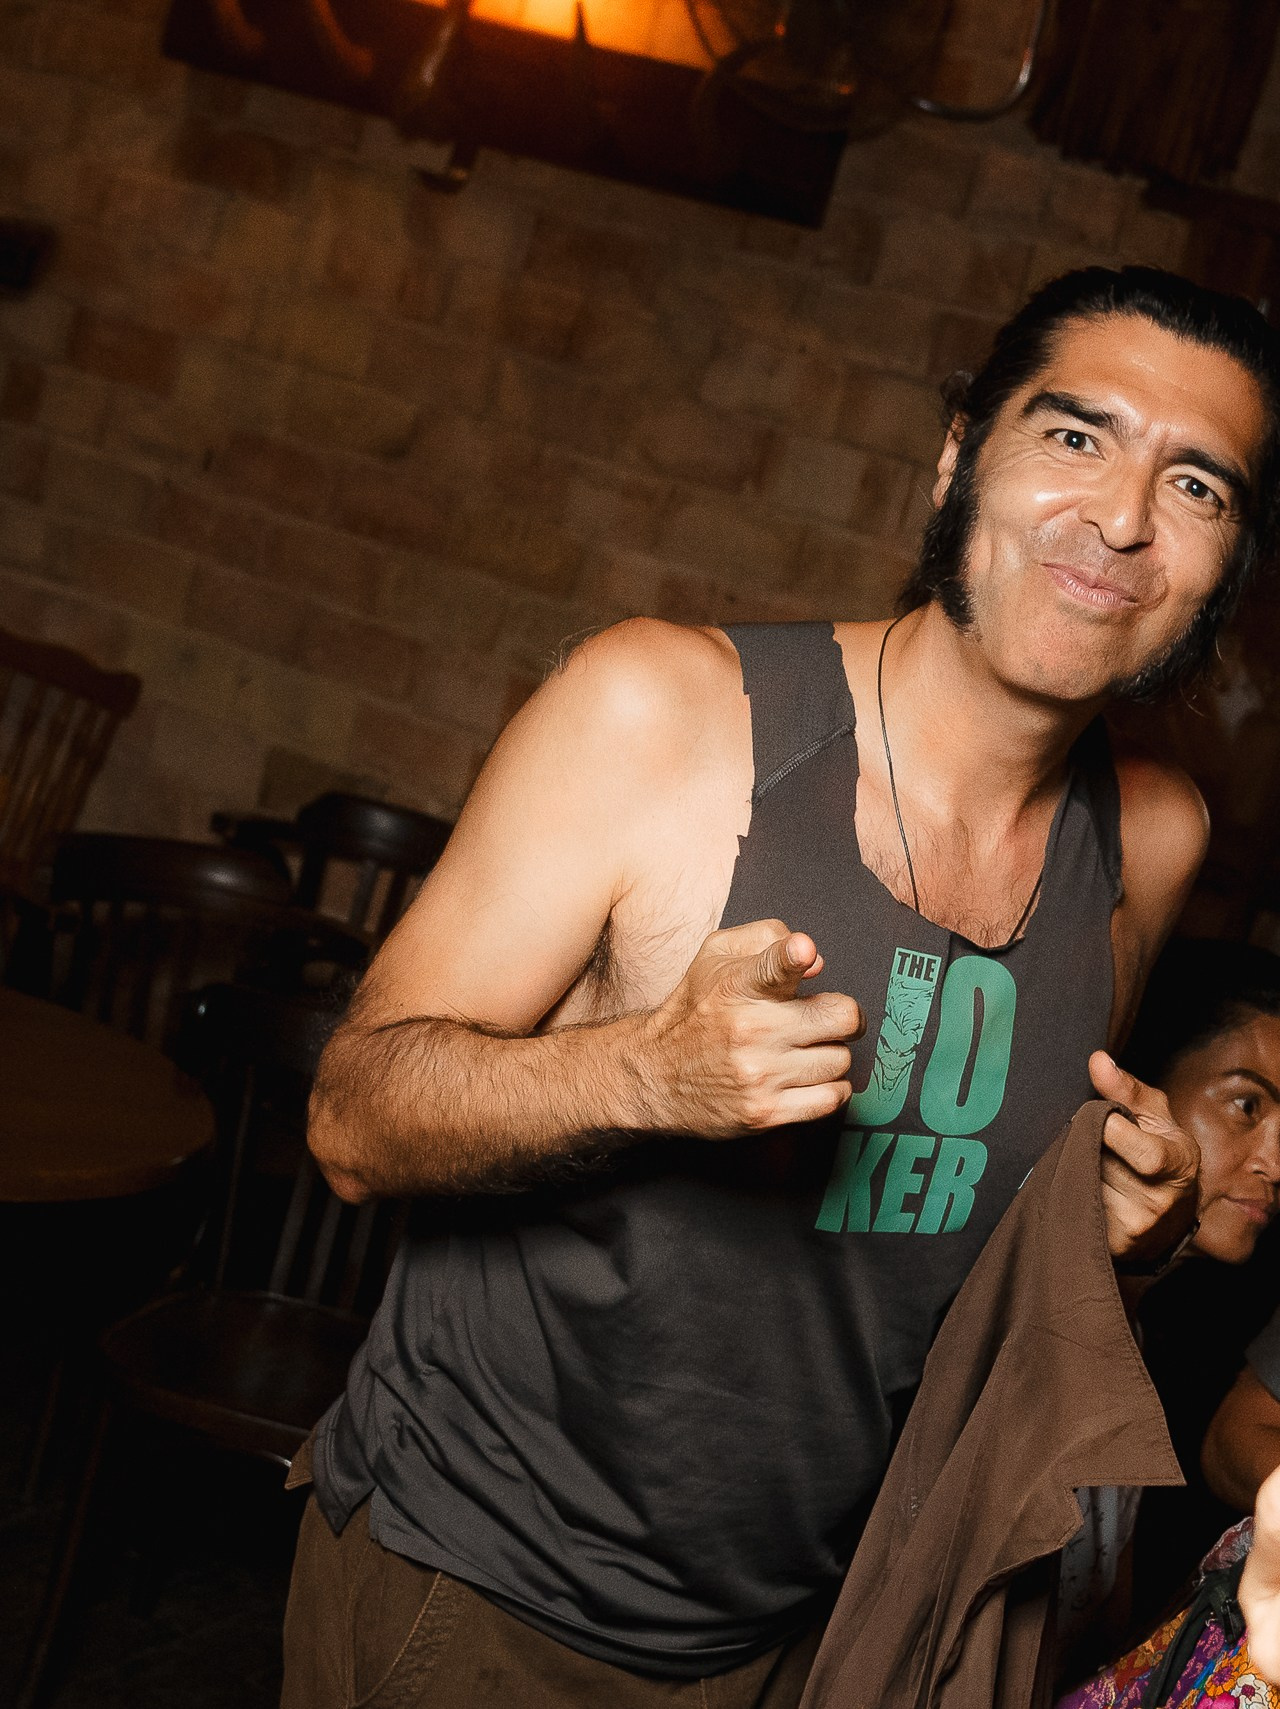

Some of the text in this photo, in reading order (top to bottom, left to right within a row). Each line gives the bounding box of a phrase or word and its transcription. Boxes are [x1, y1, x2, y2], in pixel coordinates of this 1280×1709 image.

[896, 950, 937, 983] THE
[844, 946, 1017, 1136] JO
[814, 1130, 988, 1235] KER
